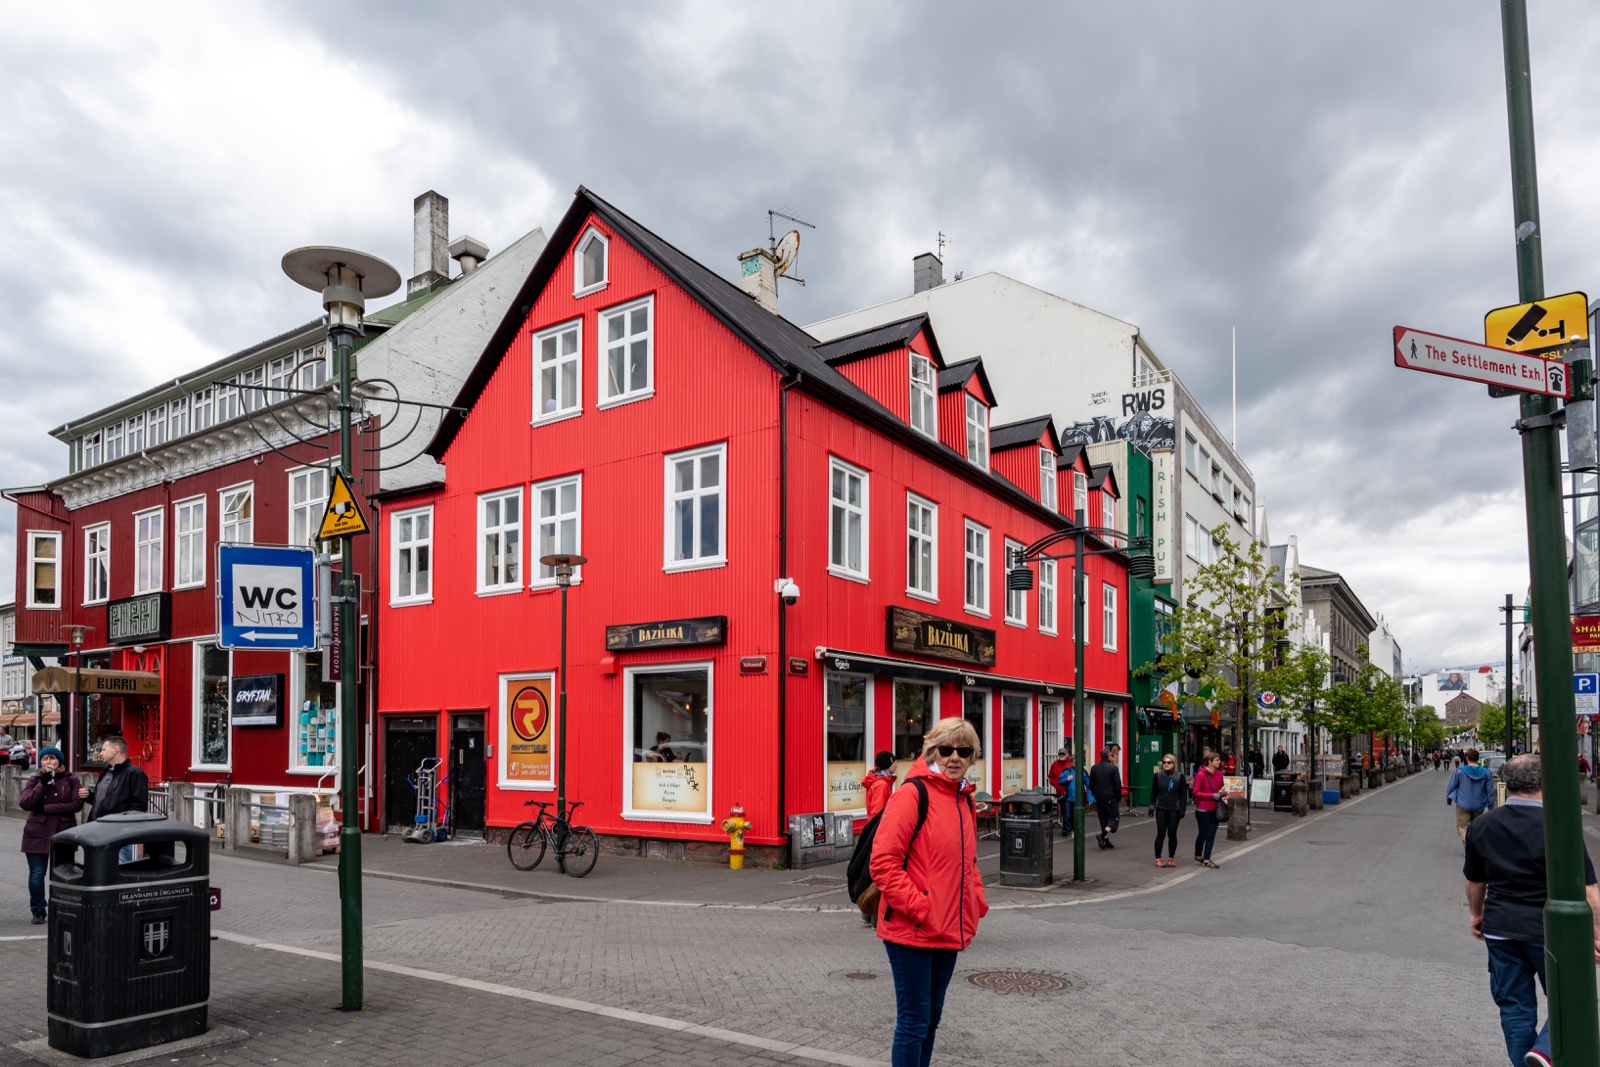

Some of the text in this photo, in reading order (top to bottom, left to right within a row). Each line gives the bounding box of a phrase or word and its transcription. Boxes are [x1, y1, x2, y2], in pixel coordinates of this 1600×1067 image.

[1425, 344, 1544, 382] The Settlement Exh.
[1121, 388, 1165, 417] RWS
[1157, 457, 1166, 575] IRISH PUB
[239, 586, 298, 609] WC
[110, 597, 160, 639] BURRO
[638, 626, 684, 643] BAZILIKA
[927, 625, 969, 653] BAZILIKA
[97, 677, 137, 691] BURRO
[1578, 678, 1591, 691] P
[469, 739, 475, 748] 3
